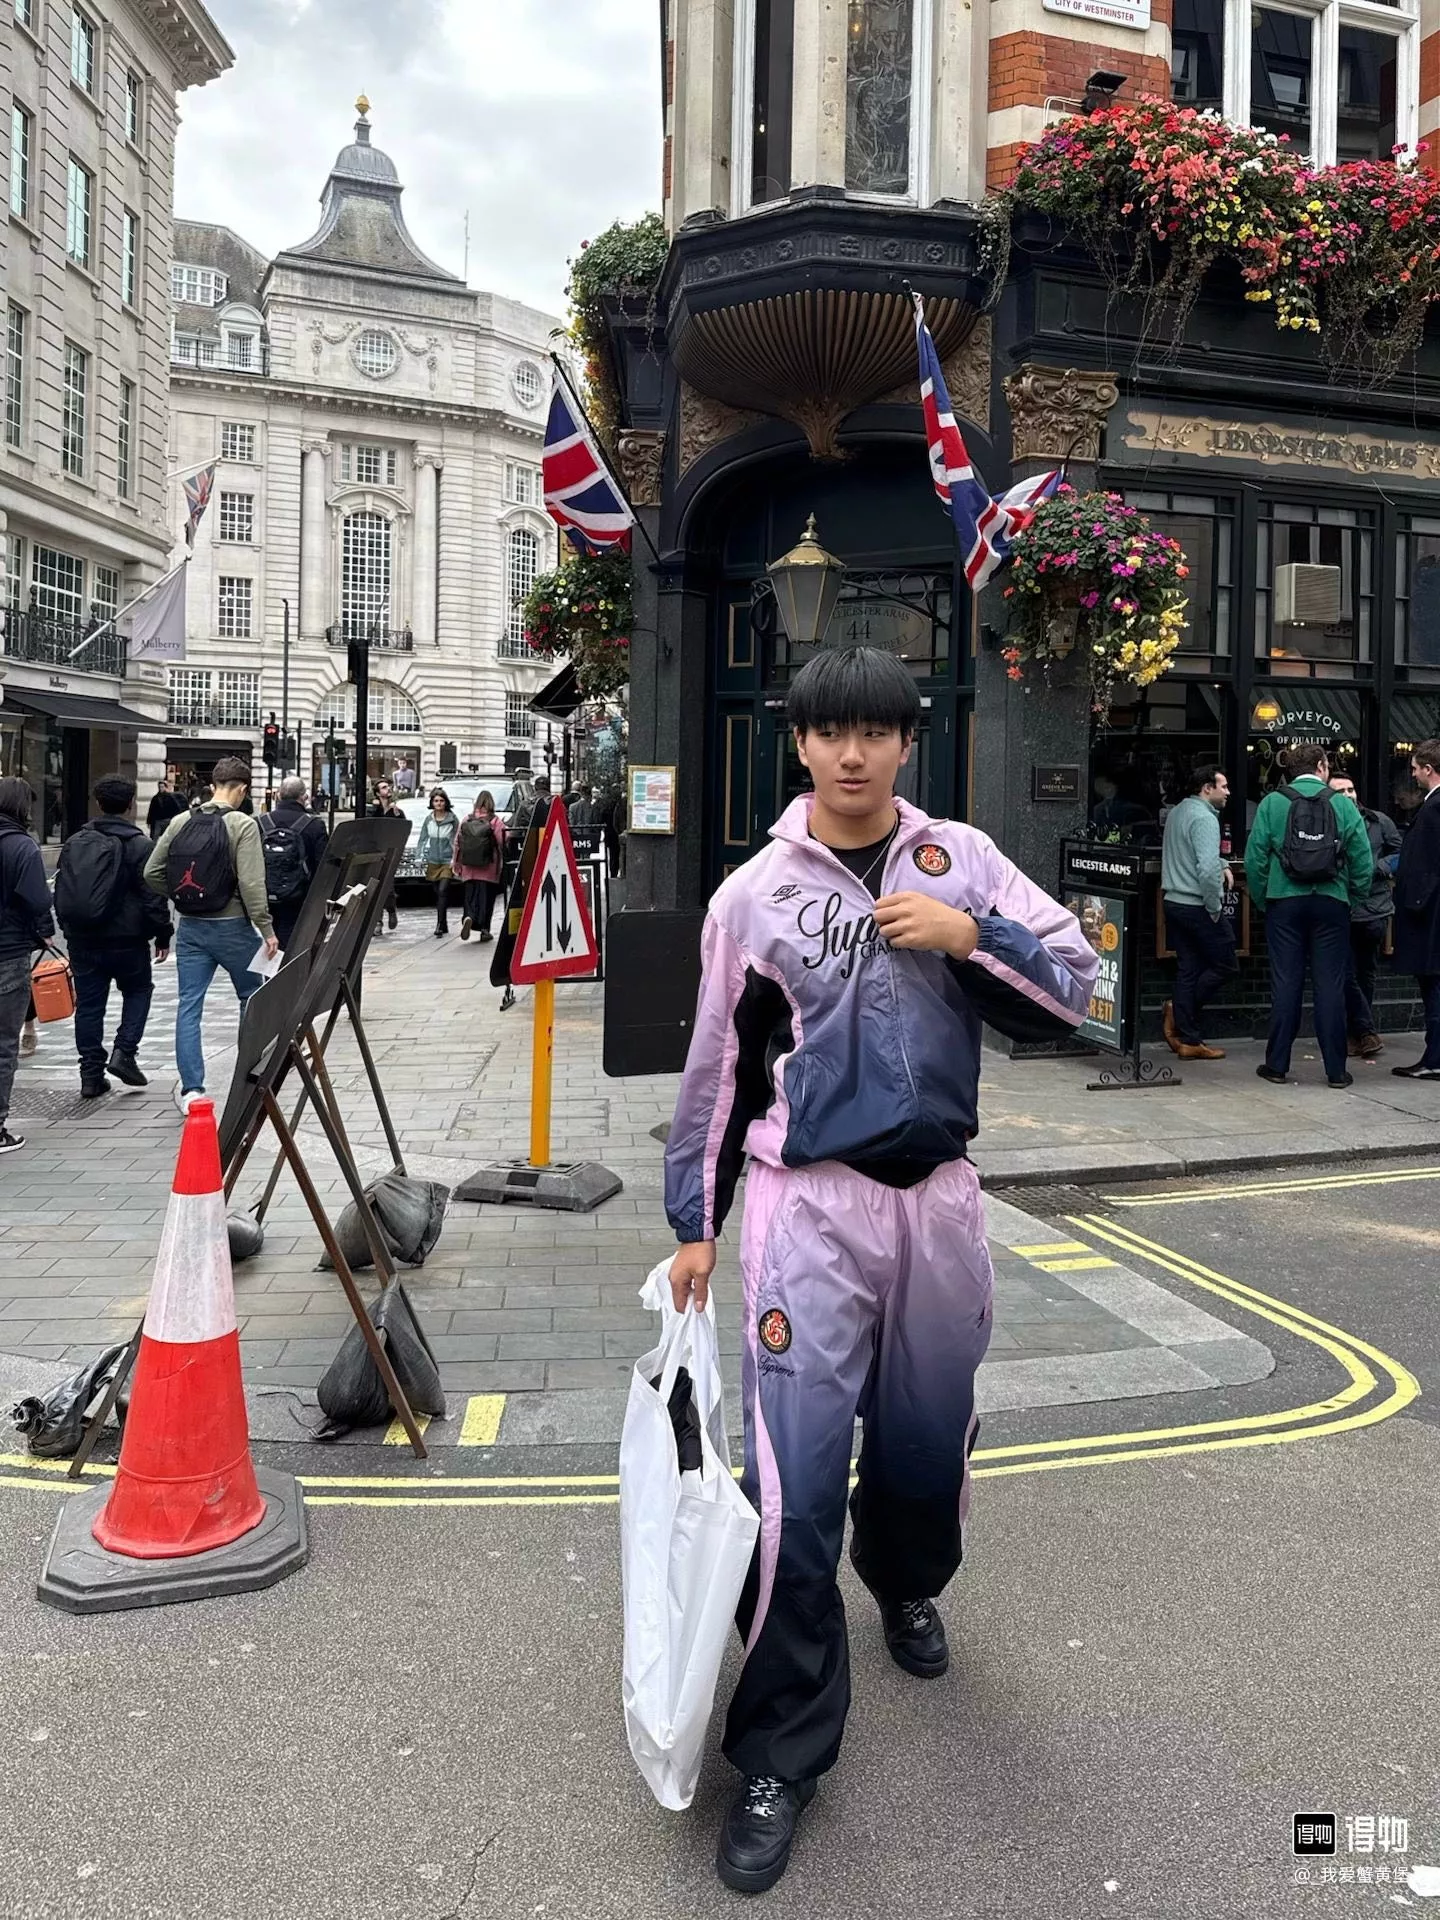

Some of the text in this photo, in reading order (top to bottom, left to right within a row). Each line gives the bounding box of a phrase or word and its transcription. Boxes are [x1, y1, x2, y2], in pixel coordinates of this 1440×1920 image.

[1073, 0, 1082, 11] OF
[1084, 4, 1134, 22] WESTMINSTER
[1355, 444, 1417, 470] ARMS
[846, 619, 872, 640] 44
[141, 639, 181, 651] Mulberry
[1267, 710, 1341, 733] PURVEYOR
[507, 741, 527, 749] Theory
[1276, 735, 1332, 746] OF QUALITY
[572, 840, 592, 849] RMS
[1071, 857, 1132, 876] LEICESTER ARMS
[1110, 960, 1119, 982] &
[1092, 977, 1116, 1003] RINK
[757, 1354, 796, 1378] Supreme
